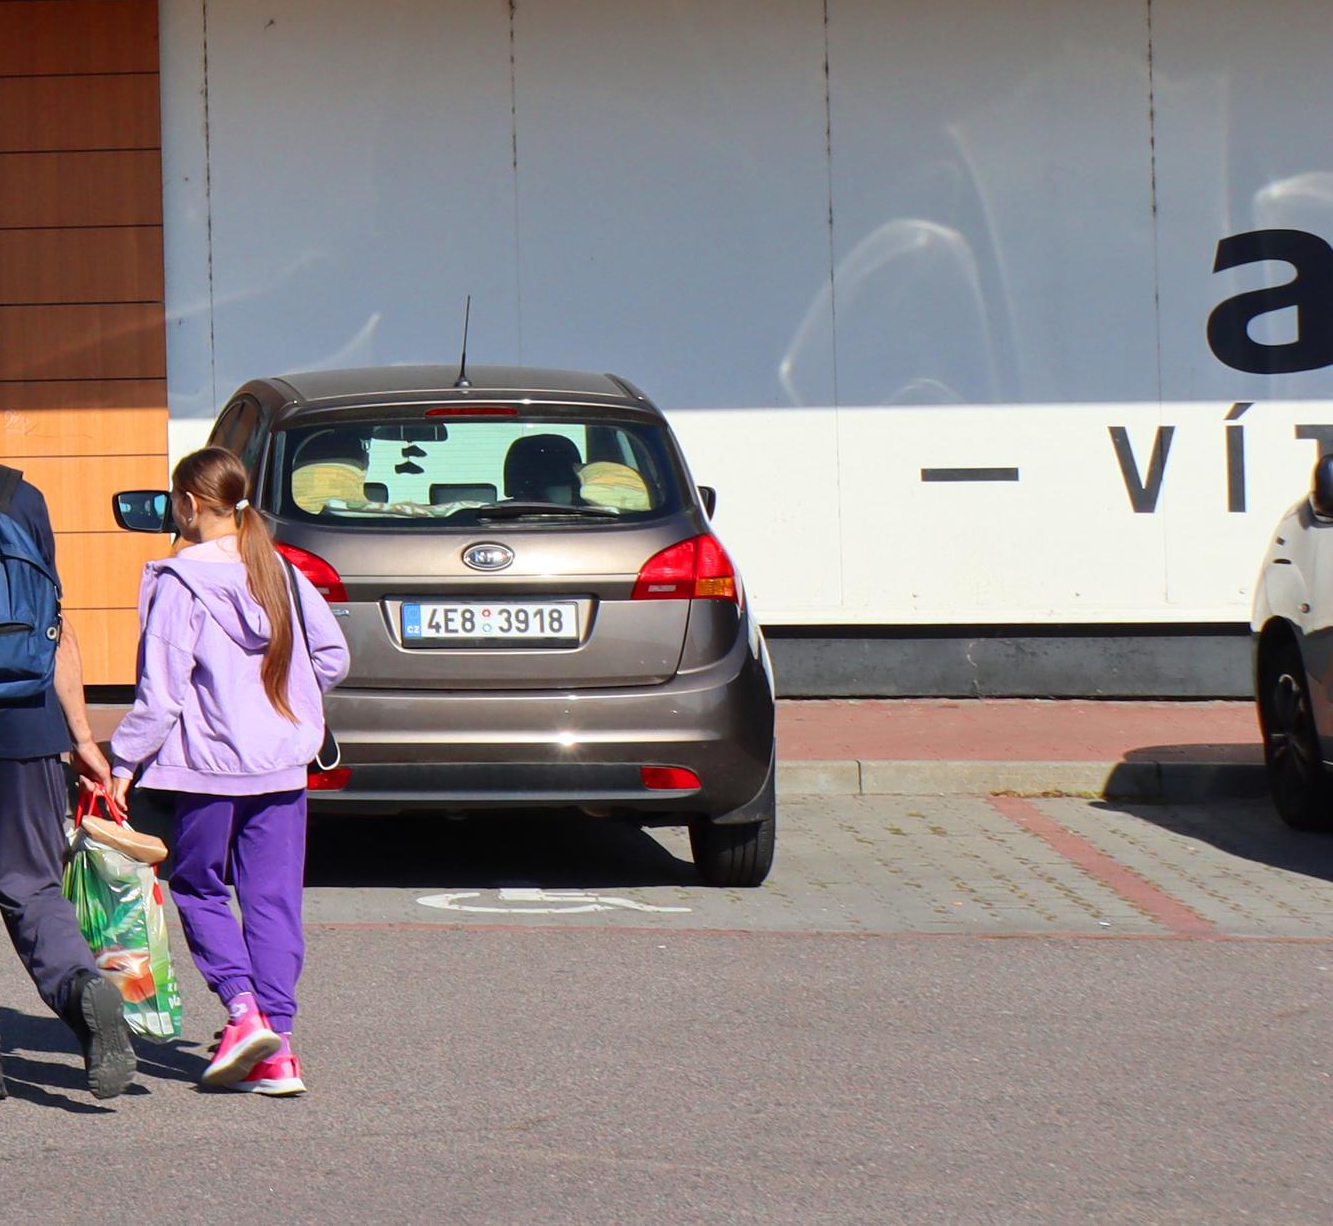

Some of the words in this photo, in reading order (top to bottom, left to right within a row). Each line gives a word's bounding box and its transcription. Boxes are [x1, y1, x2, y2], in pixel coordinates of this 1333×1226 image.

[427, 608, 475, 633] 4E8
[498, 608, 564, 633] 3918
[406, 626, 421, 635] CZ
